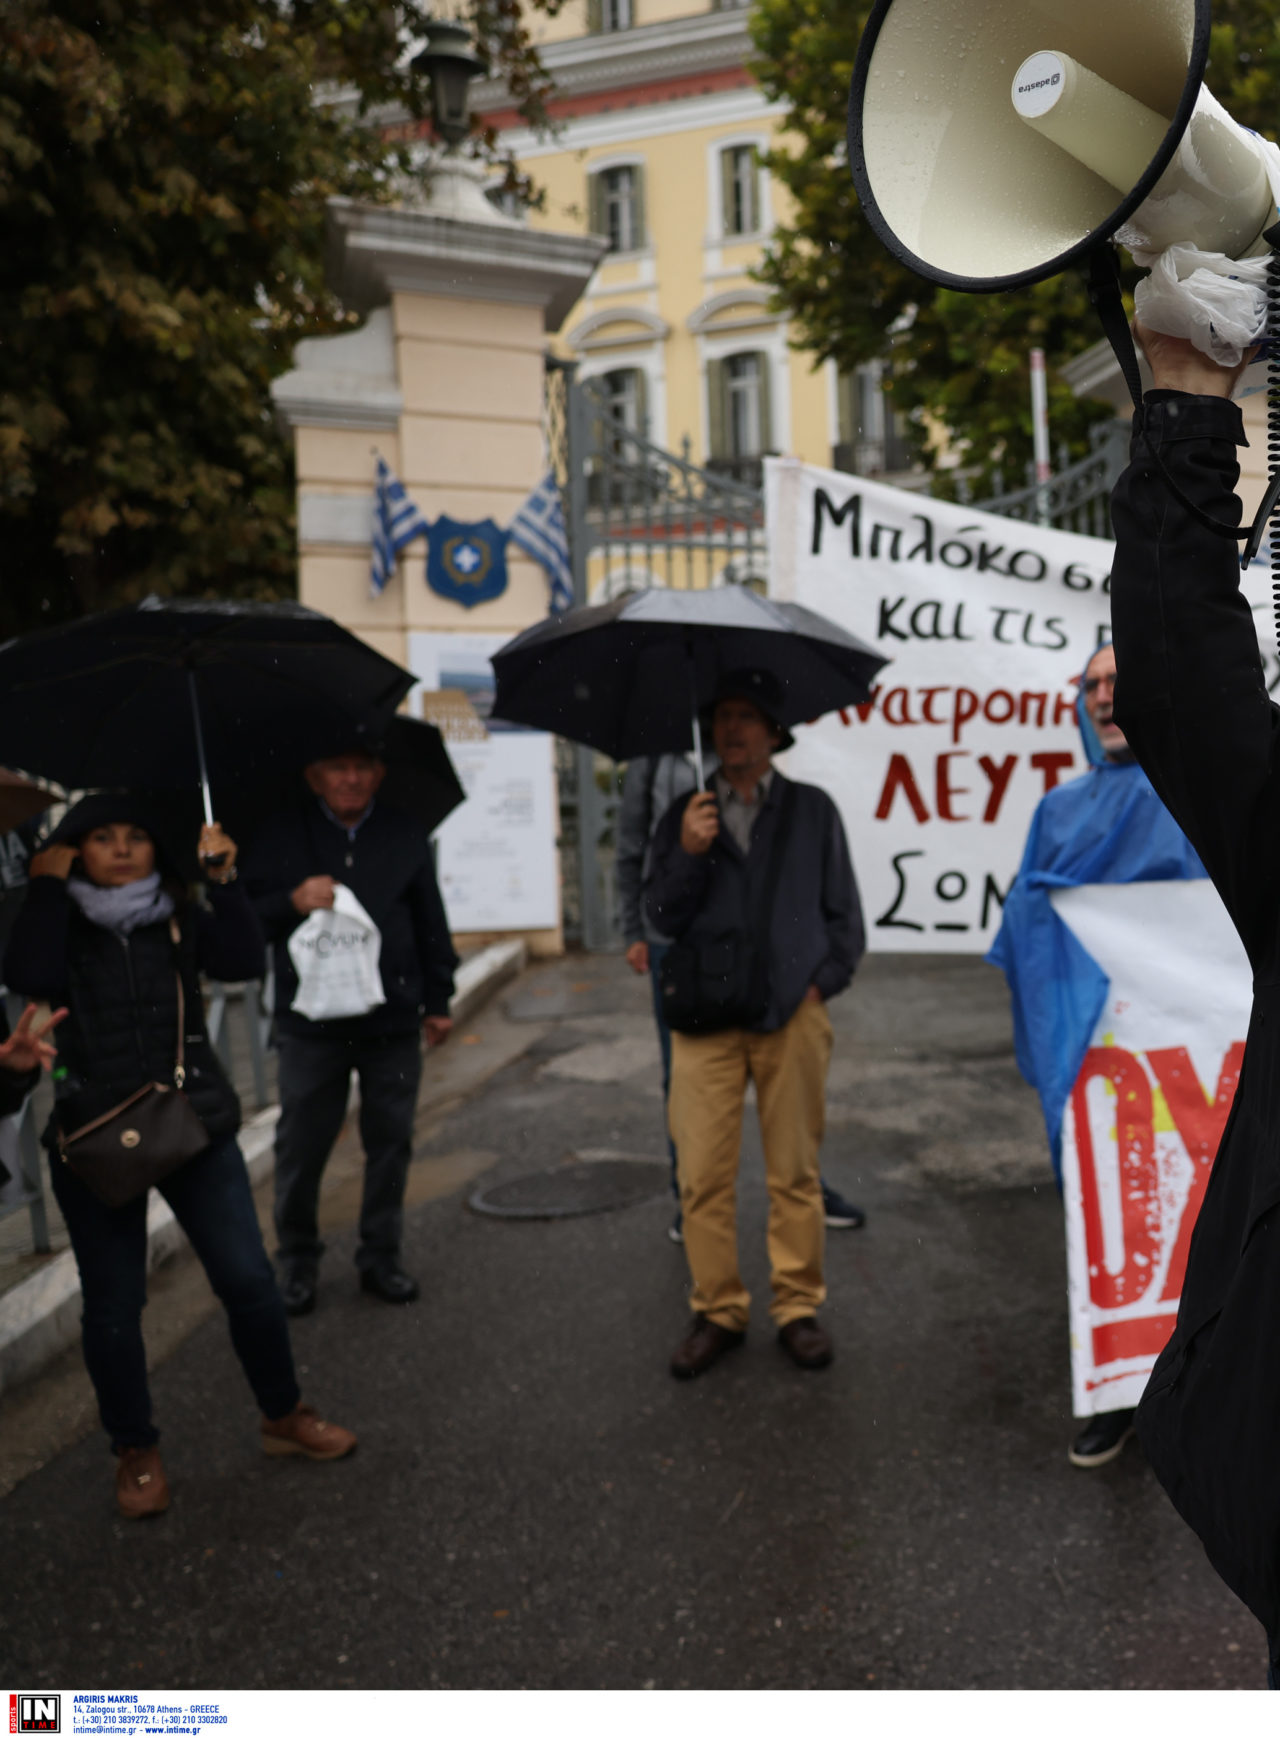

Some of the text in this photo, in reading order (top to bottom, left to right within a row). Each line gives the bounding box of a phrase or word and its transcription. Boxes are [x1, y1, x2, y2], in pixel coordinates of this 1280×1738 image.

[1018, 78, 1050, 93] adastra
[811, 487, 1047, 583] Μπλόκο
[877, 596, 975, 642] και
[989, 605, 1069, 651] τις
[873, 750, 1073, 825] ΛΕΥΤ
